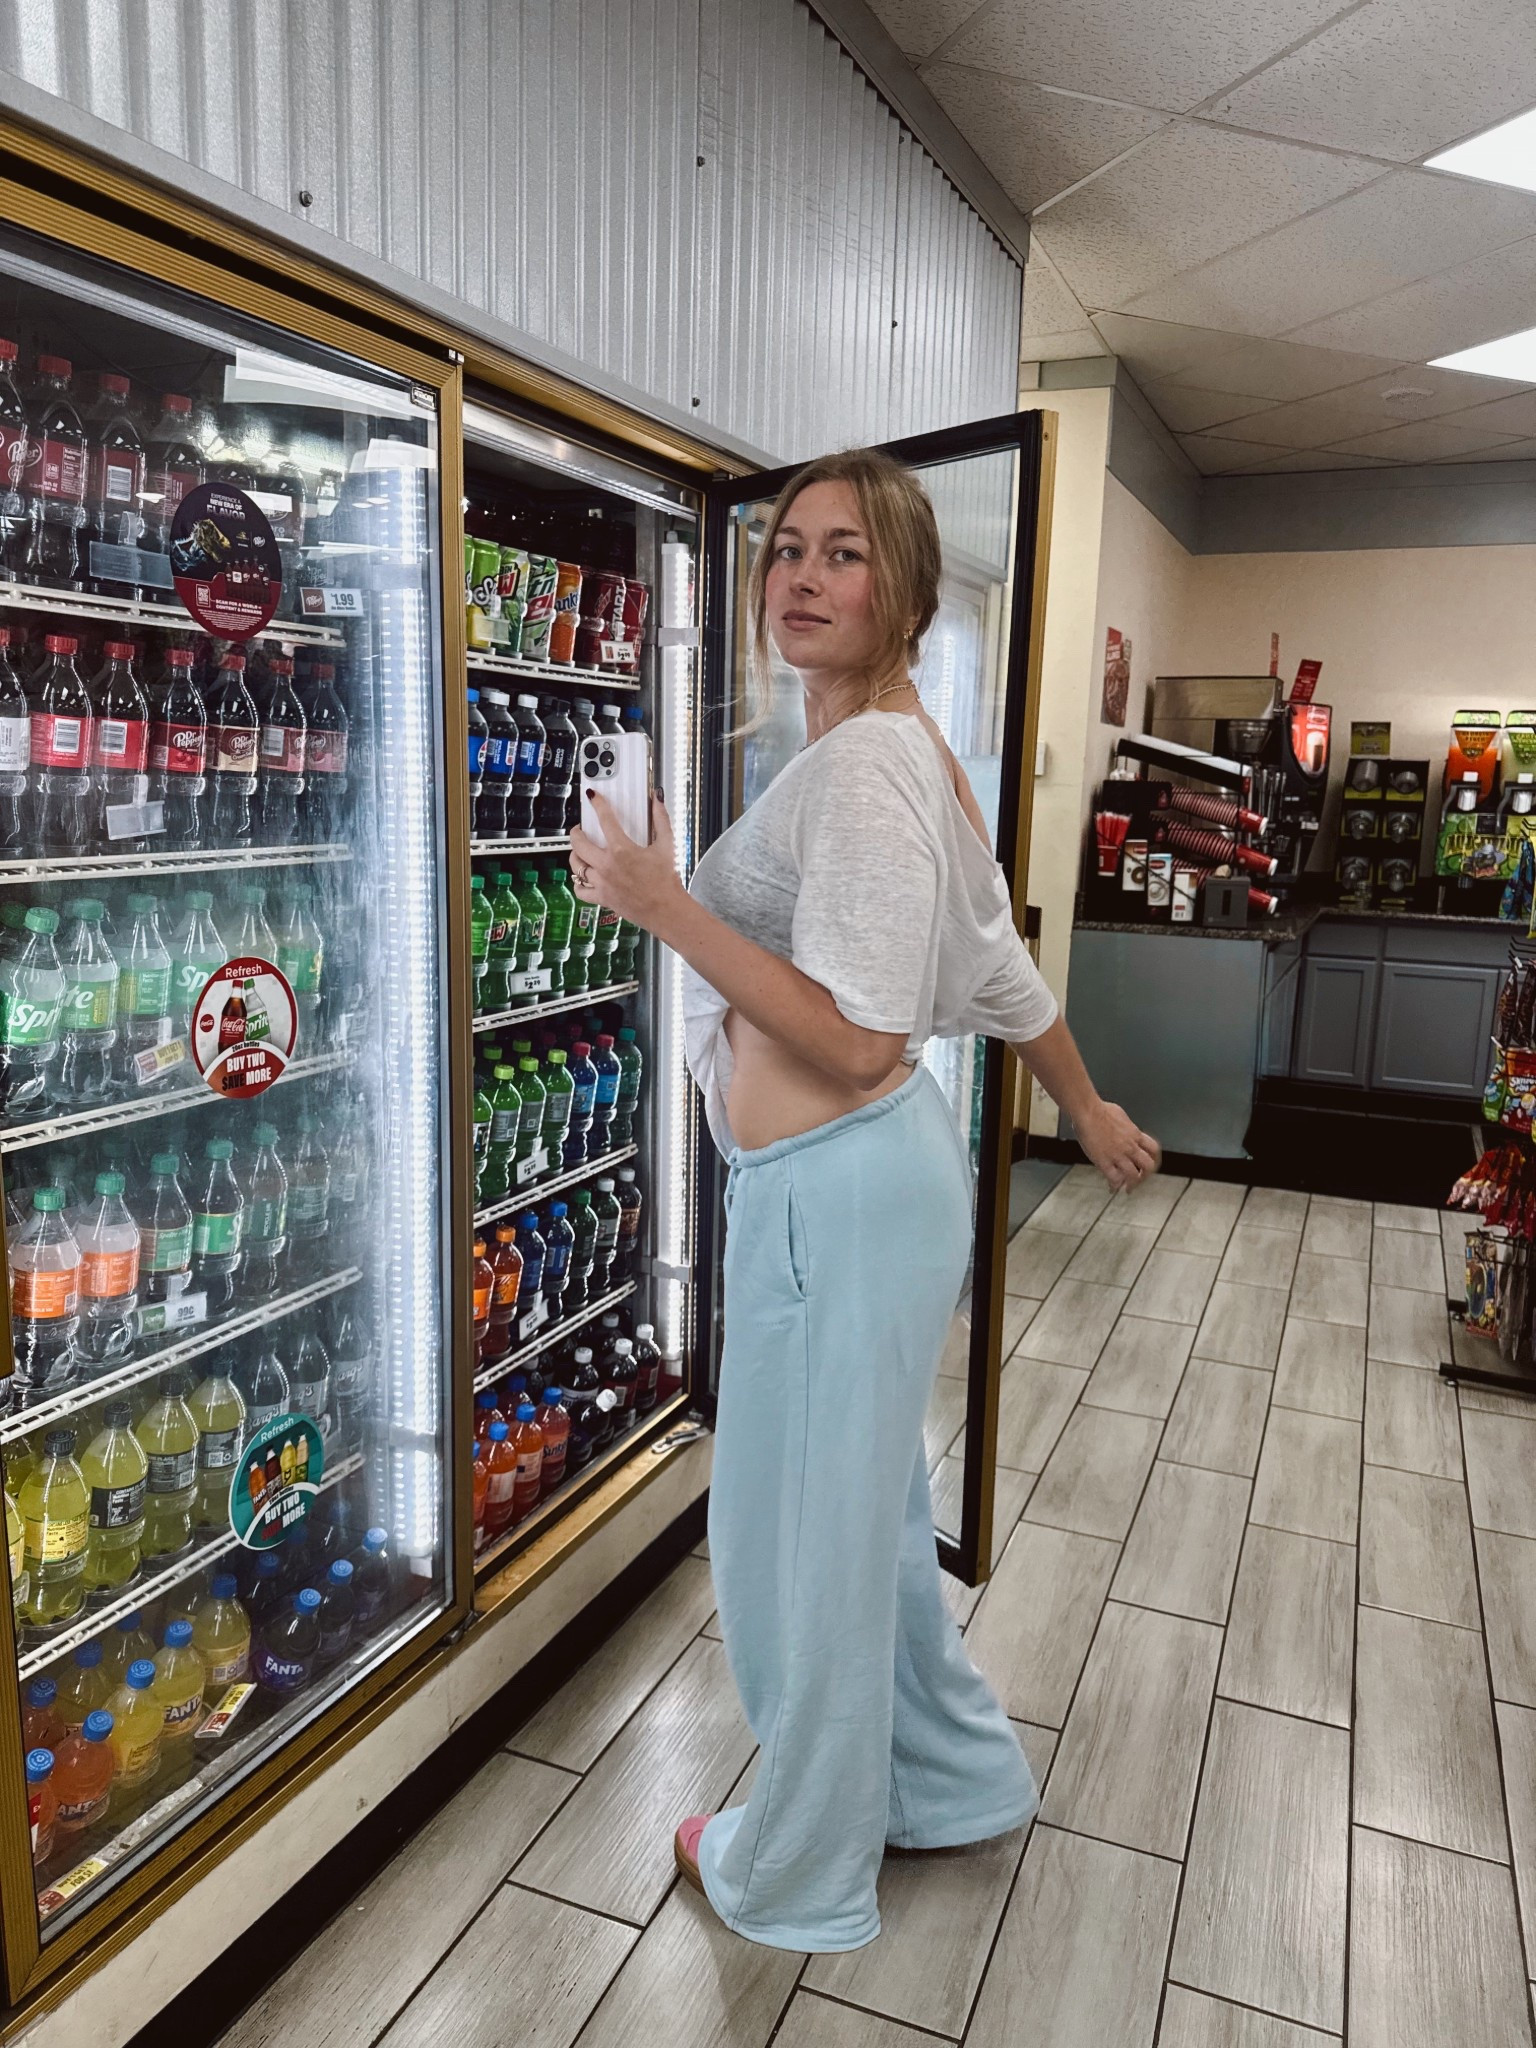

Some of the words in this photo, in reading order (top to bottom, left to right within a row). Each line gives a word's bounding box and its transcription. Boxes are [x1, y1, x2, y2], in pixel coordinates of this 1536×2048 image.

[206, 504, 246, 521] FLAVOR
[210, 498, 221, 506] NEW
[222, 500, 234, 509] ERA
[235, 502, 243, 511] OF
[173, 732, 202, 748] Pepper
[186, 730, 196, 740] Dr
[225, 964, 262, 979] Refresh
[226, 1055, 246, 1072] BUY
[246, 1051, 266, 1068] TWO
[246, 1066, 272, 1086] MORE
[260, 1416, 294, 1442] Refresh
[264, 1502, 282, 1525] BUY
[282, 1492, 300, 1512] TWO
[282, 1502, 306, 1528] MORE
